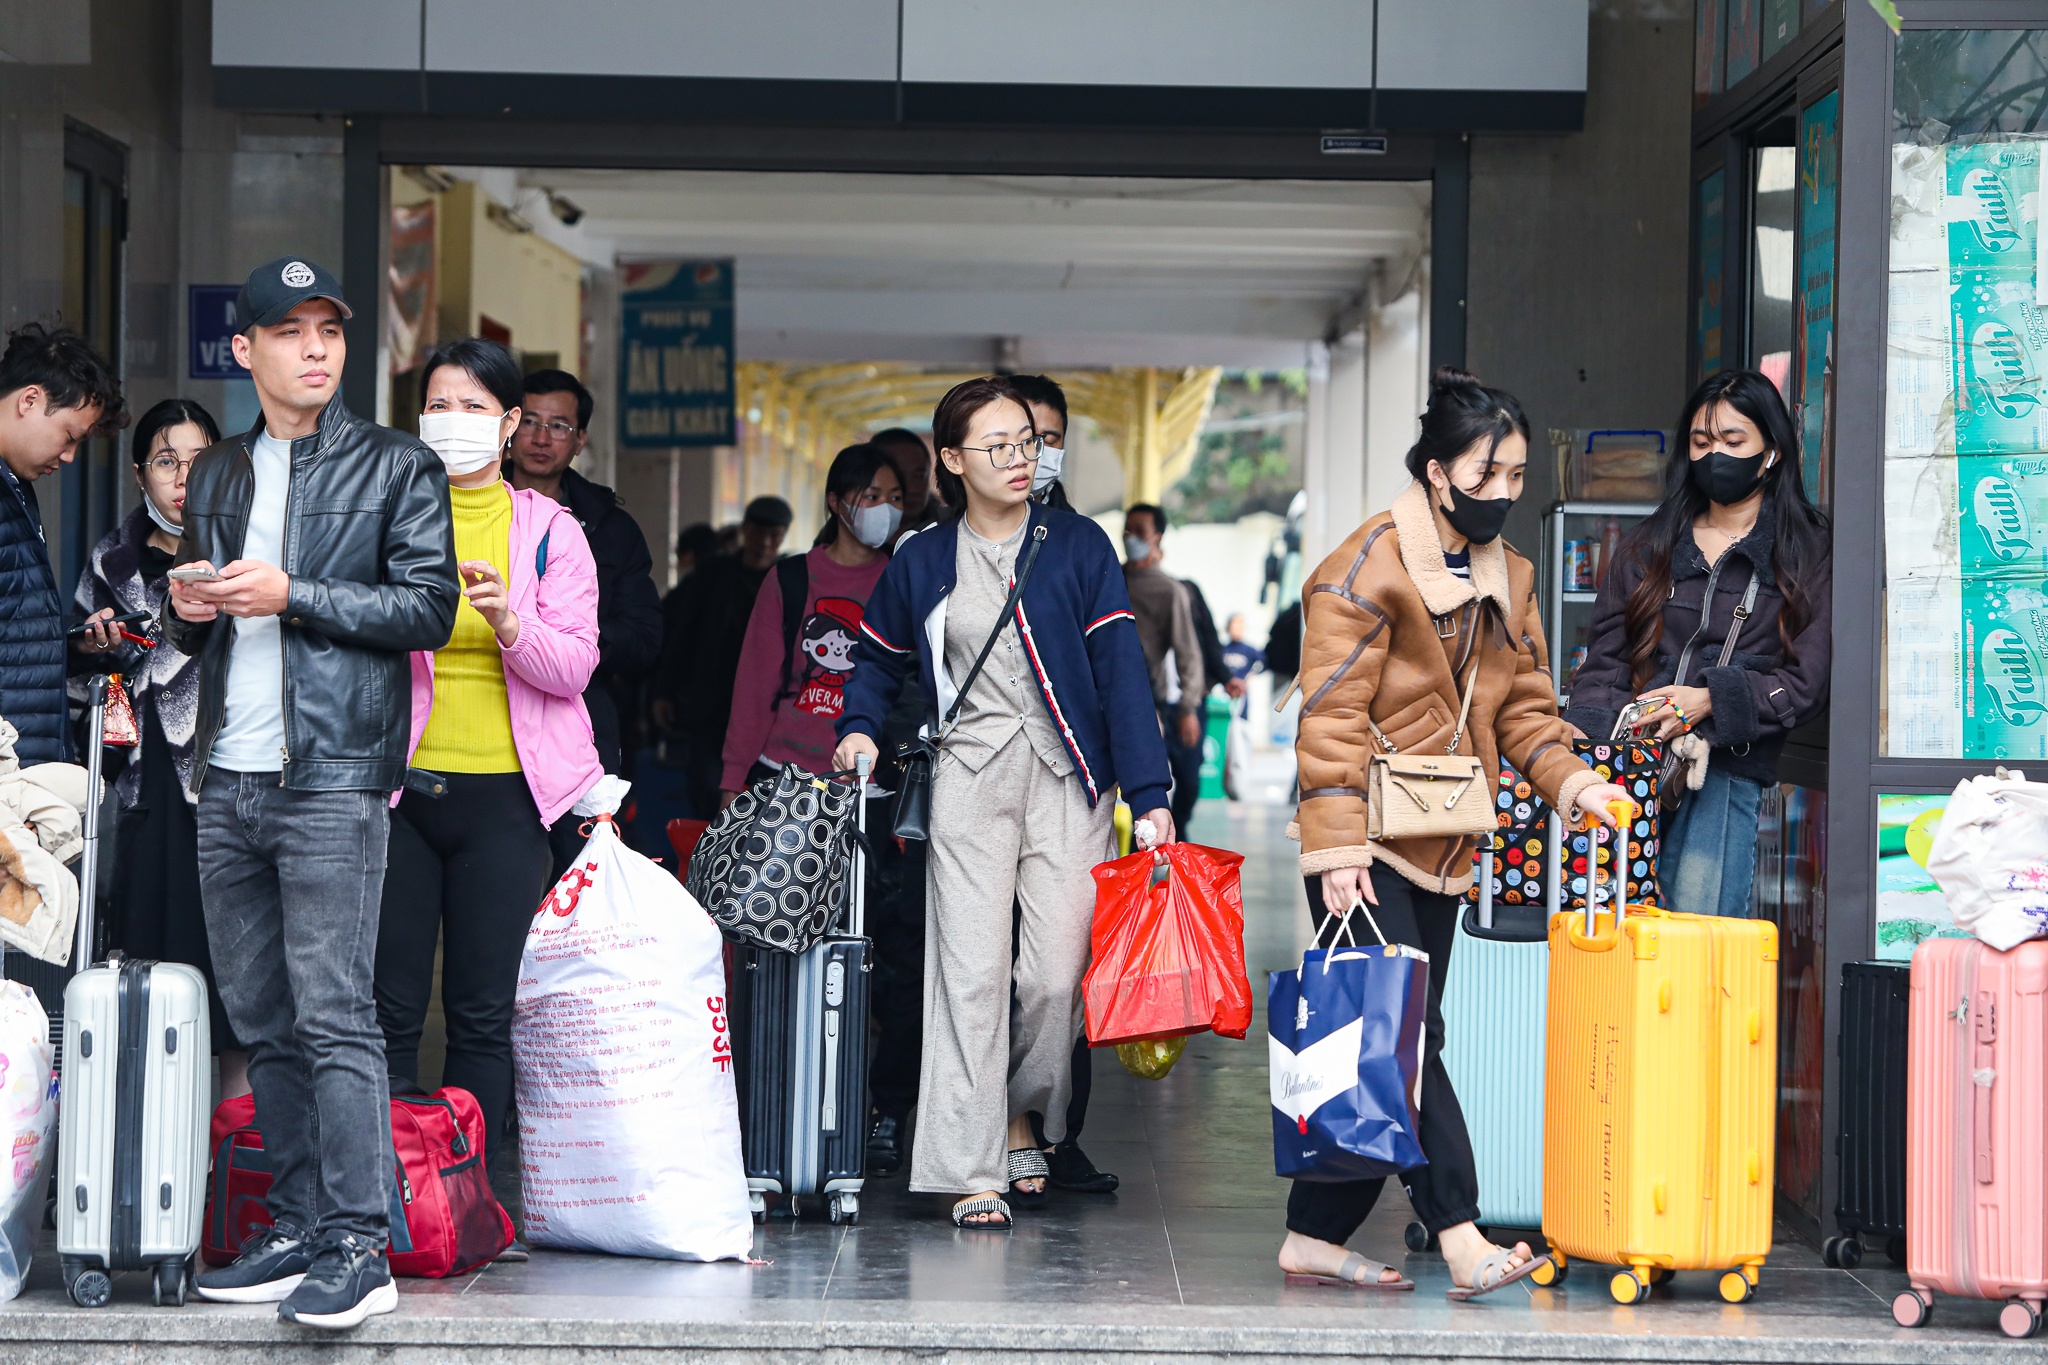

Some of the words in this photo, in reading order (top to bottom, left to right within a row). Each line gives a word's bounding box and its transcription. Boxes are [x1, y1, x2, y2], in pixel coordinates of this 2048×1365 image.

[1969, 170, 2023, 253] Faith
[1975, 324, 2042, 419] Faith
[1976, 479, 2034, 562] Faith
[1983, 633, 2048, 727] Faith
[706, 996, 732, 1074] 553F
